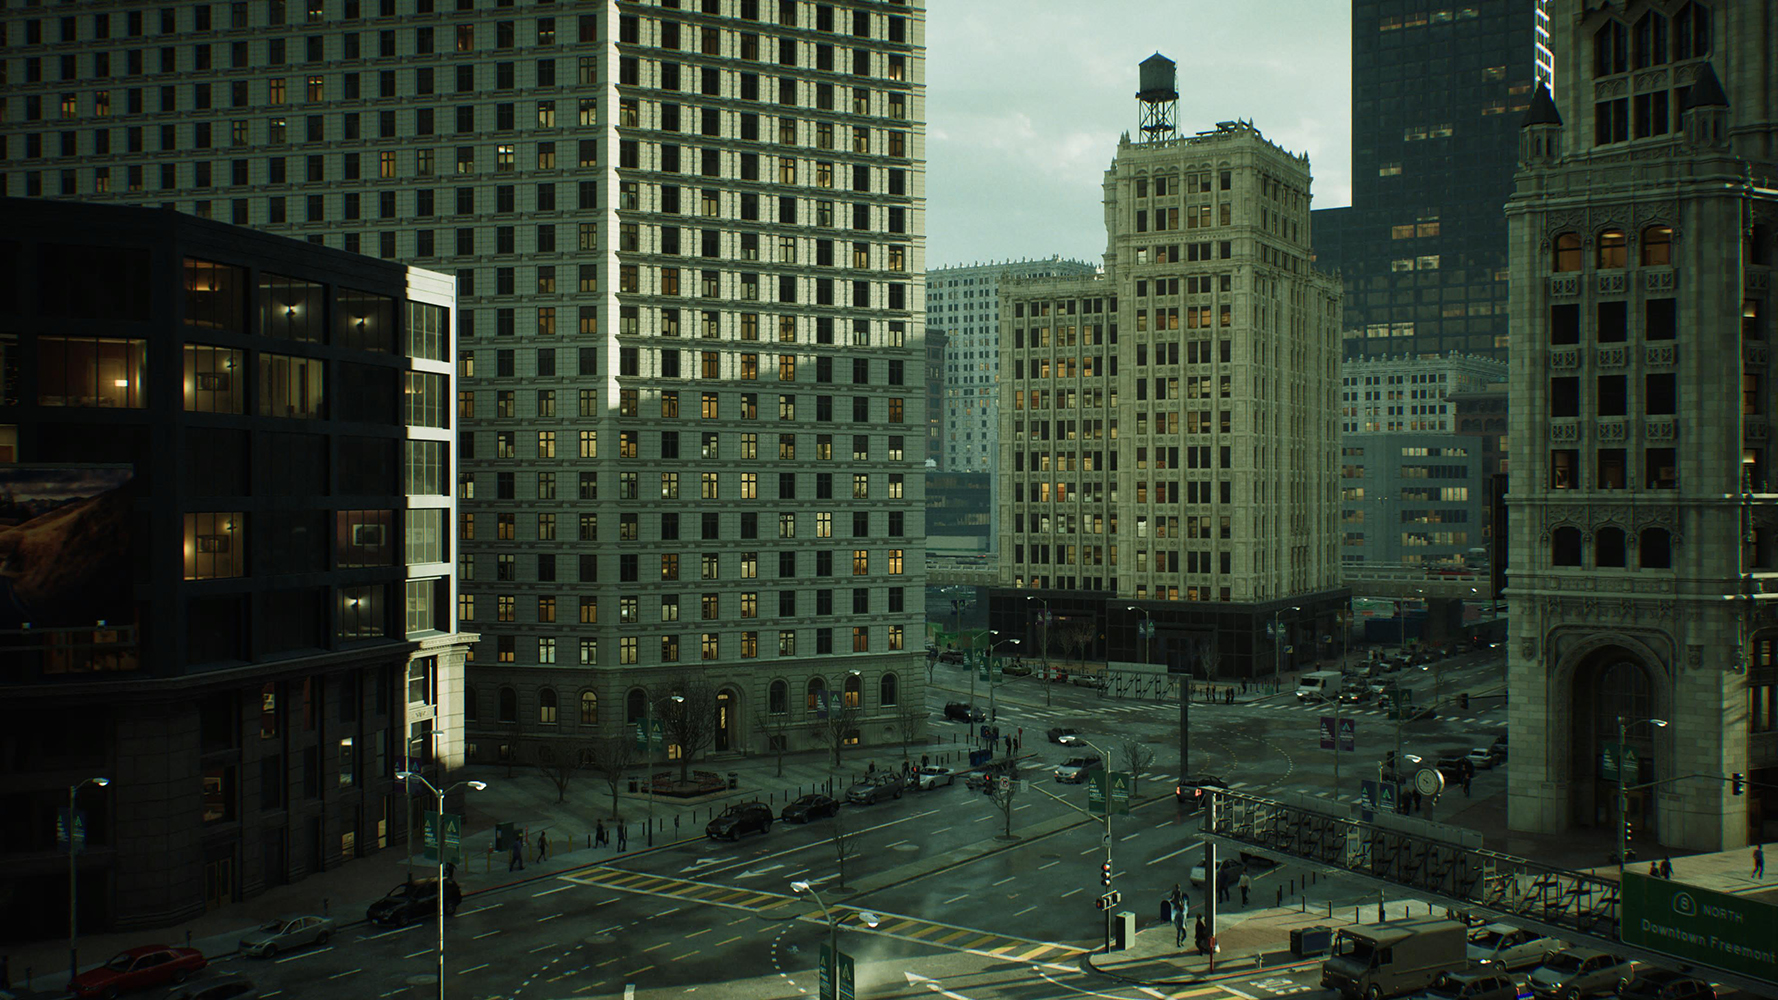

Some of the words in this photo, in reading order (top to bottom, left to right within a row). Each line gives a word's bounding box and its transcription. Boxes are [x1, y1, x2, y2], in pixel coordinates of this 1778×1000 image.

[1703, 904, 1744, 924] NORTH
[1641, 918, 1706, 946] Downtown
[1710, 935, 1777, 963] Freemont
